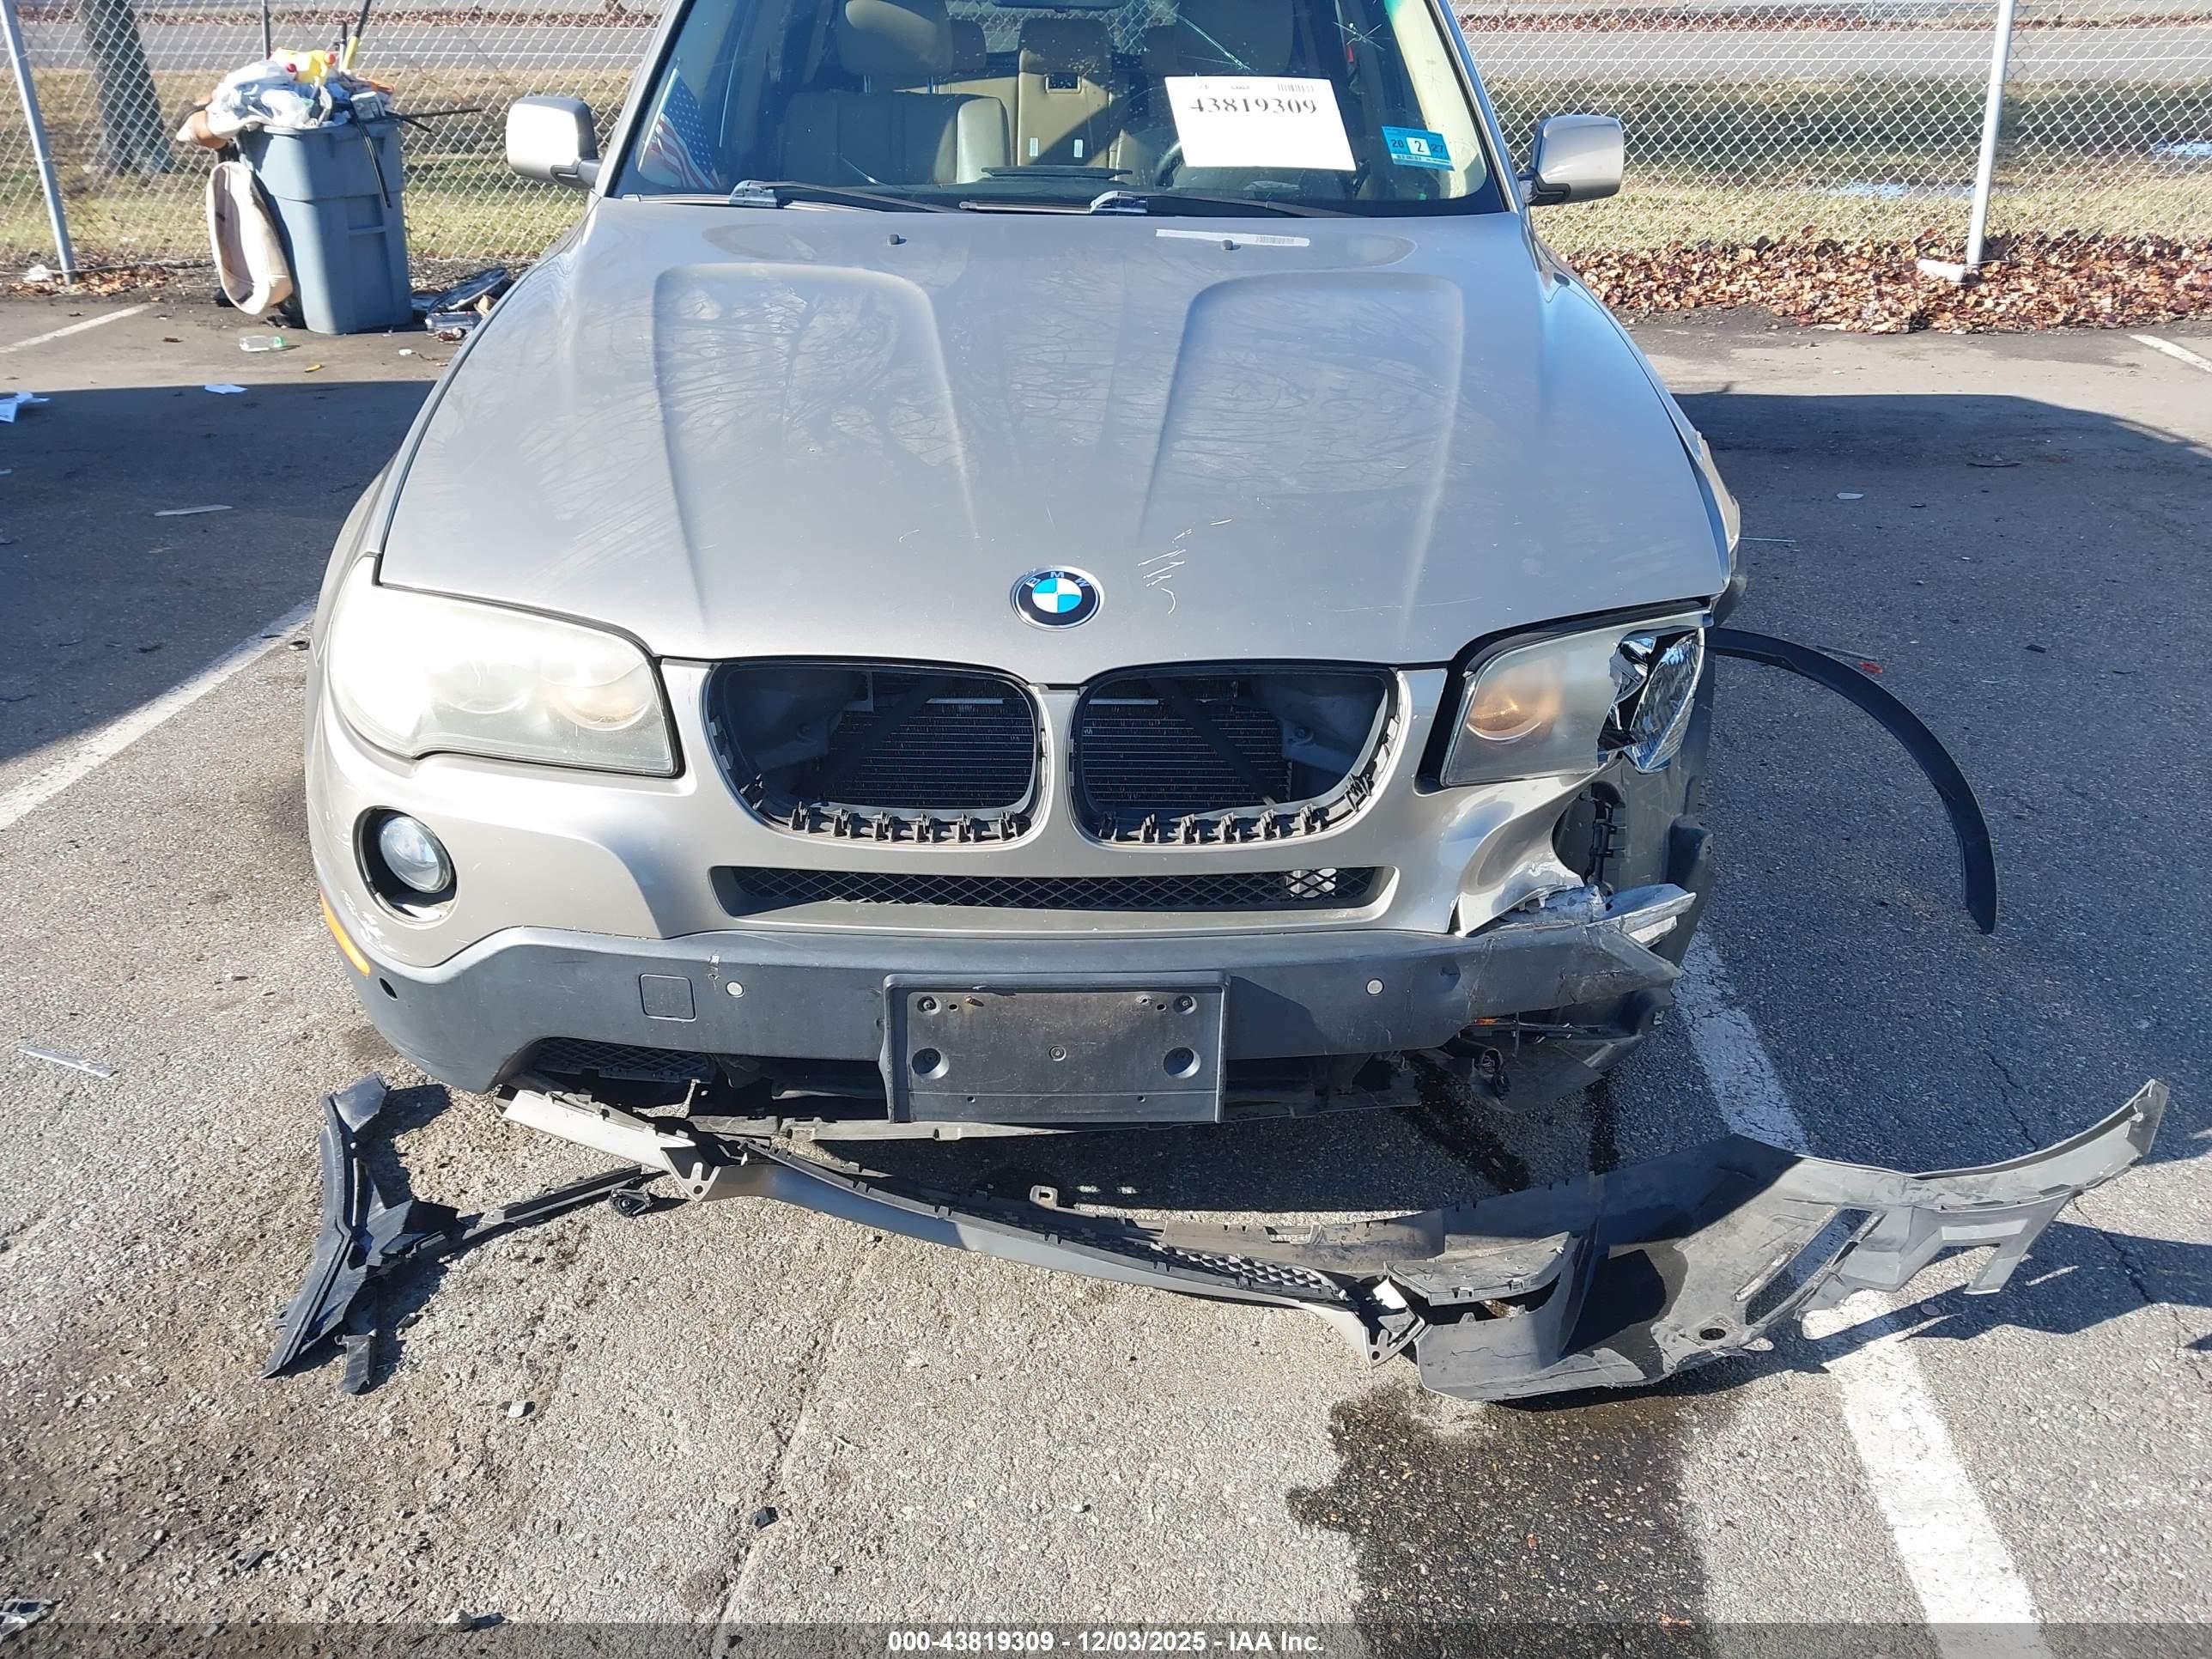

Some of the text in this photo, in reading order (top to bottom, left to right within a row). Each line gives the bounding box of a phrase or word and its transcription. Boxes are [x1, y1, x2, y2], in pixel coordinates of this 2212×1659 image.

[1190, 97, 1317, 113] 43819309
[1391, 139, 1404, 148] 20
[1414, 140, 1425, 153] 2
[1026, 571, 1091, 587] BMW
